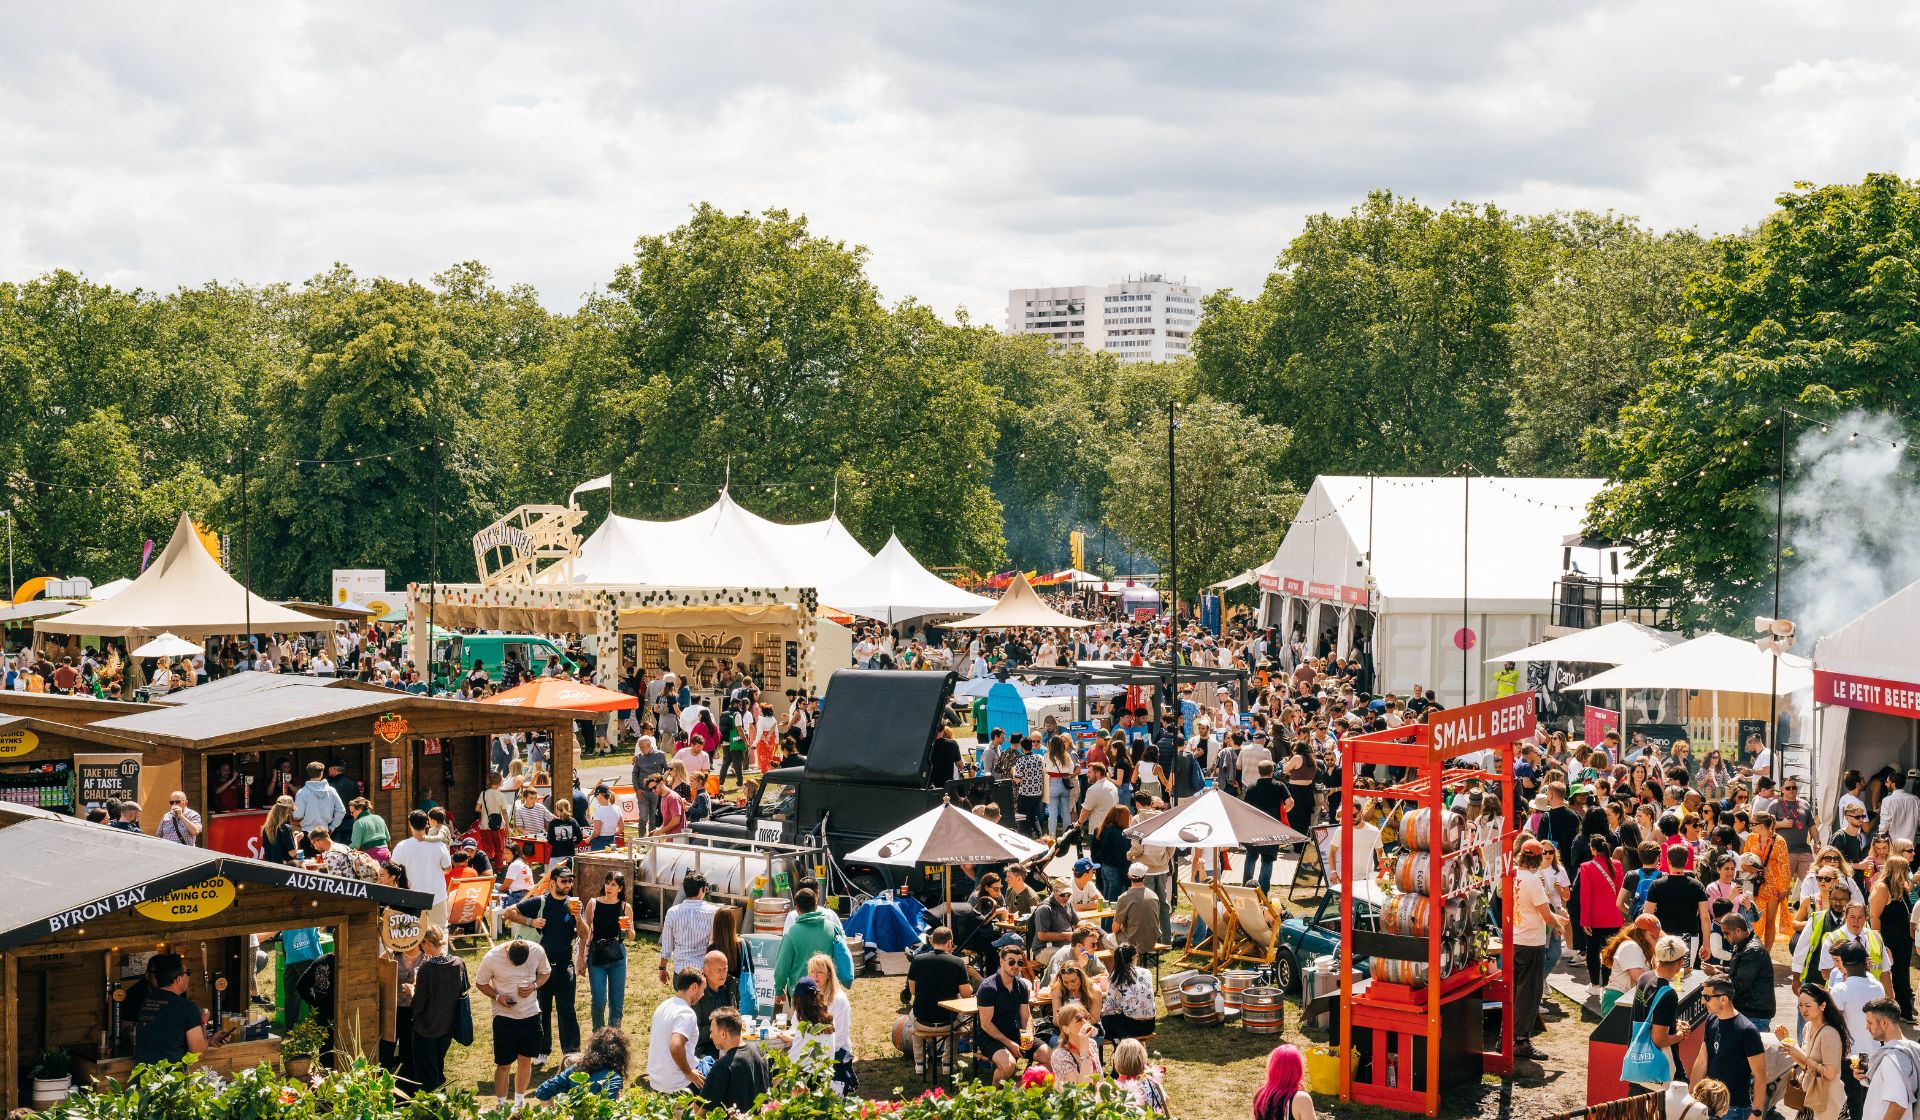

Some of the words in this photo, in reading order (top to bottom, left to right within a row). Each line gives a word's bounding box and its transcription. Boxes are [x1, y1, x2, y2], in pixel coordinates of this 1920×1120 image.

[1556, 667, 1576, 686] Cano
[1833, 680, 1847, 698] LE
[1850, 682, 1881, 704] PETIT
[1433, 714, 1486, 750] SMALL
[1491, 704, 1525, 736] BEER
[1743, 724, 1761, 732] Cano
[83, 768, 102, 777] TAKE
[103, 768, 118, 777] THE
[84, 779, 95, 788] AF
[97, 778, 122, 788] TASTE
[191, 879, 224, 889] WOOD
[286, 873, 368, 898] AUSTRALIA
[201, 890, 219, 899] CO.
[49, 898, 111, 933] BYRON
[115, 886, 148, 909] BAY
[171, 904, 199, 915] CB24
[389, 913, 420, 926] STONE
[390, 926, 420, 939] WOOD
